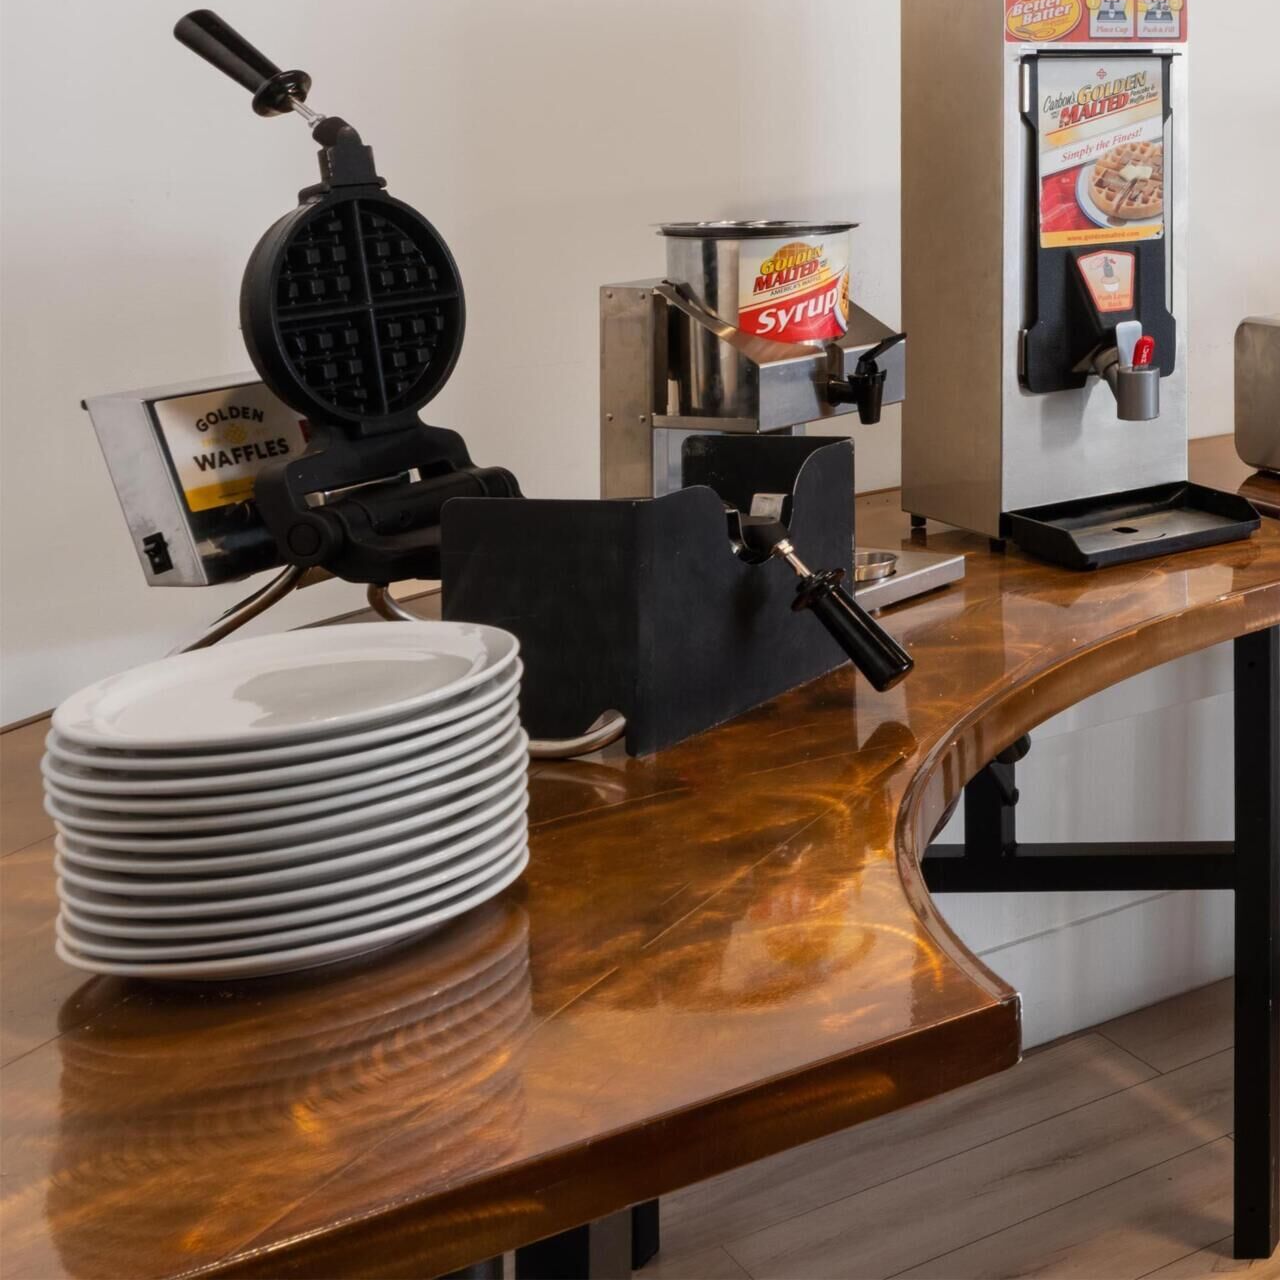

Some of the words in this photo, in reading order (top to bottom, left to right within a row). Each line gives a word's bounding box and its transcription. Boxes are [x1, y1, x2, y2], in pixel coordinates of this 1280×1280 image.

[1023, 4, 1073, 26] Batter
[1043, 91, 1076, 113] Carbon's
[1076, 70, 1148, 105] GOLDEN
[1058, 92, 1130, 128] MALTED
[1061, 145, 1094, 162] Simply
[1095, 139, 1111, 151] the
[1111, 127, 1143, 146] Finest!
[753, 259, 819, 293] MALTED
[760, 244, 824, 275] GOLDEN
[755, 287, 838, 334] Syrup
[195, 406, 264, 432] GOLDEN
[193, 438, 289, 471] WAFFLES
